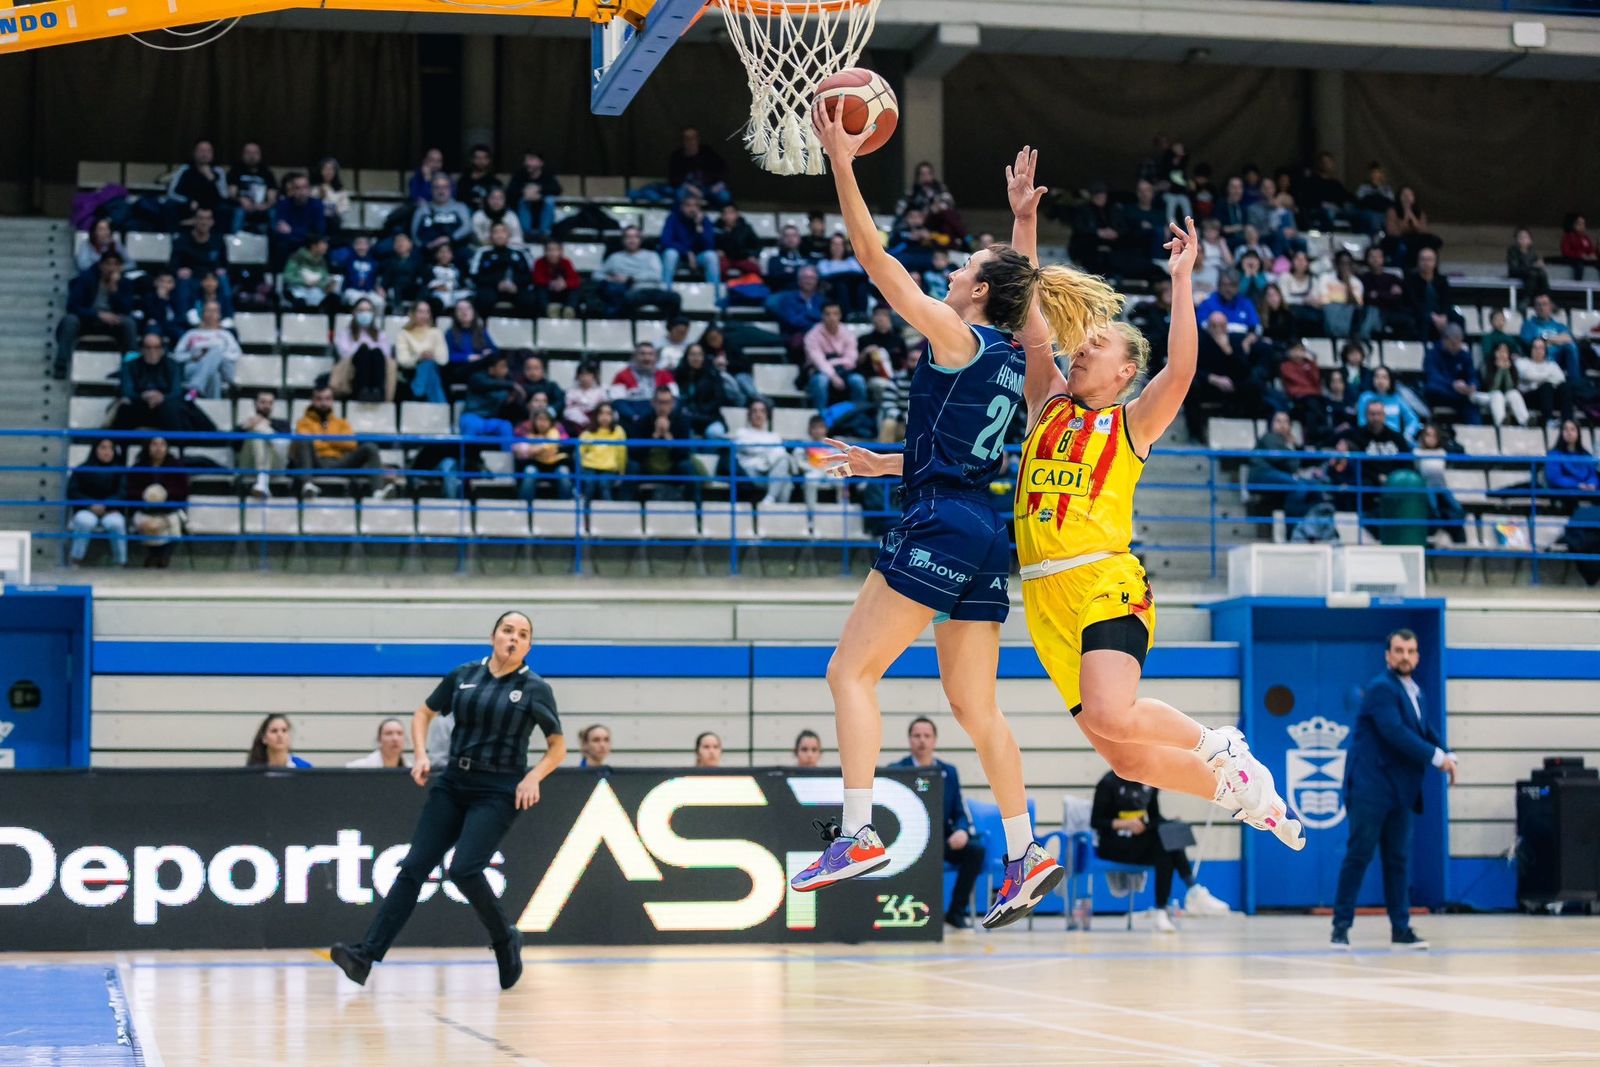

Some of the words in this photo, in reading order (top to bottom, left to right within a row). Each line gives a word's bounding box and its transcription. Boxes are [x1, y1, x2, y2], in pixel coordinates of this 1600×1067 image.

[996, 364, 1025, 397] HERM
[1057, 430, 1073, 453] 8
[516, 776, 931, 932] ASP
